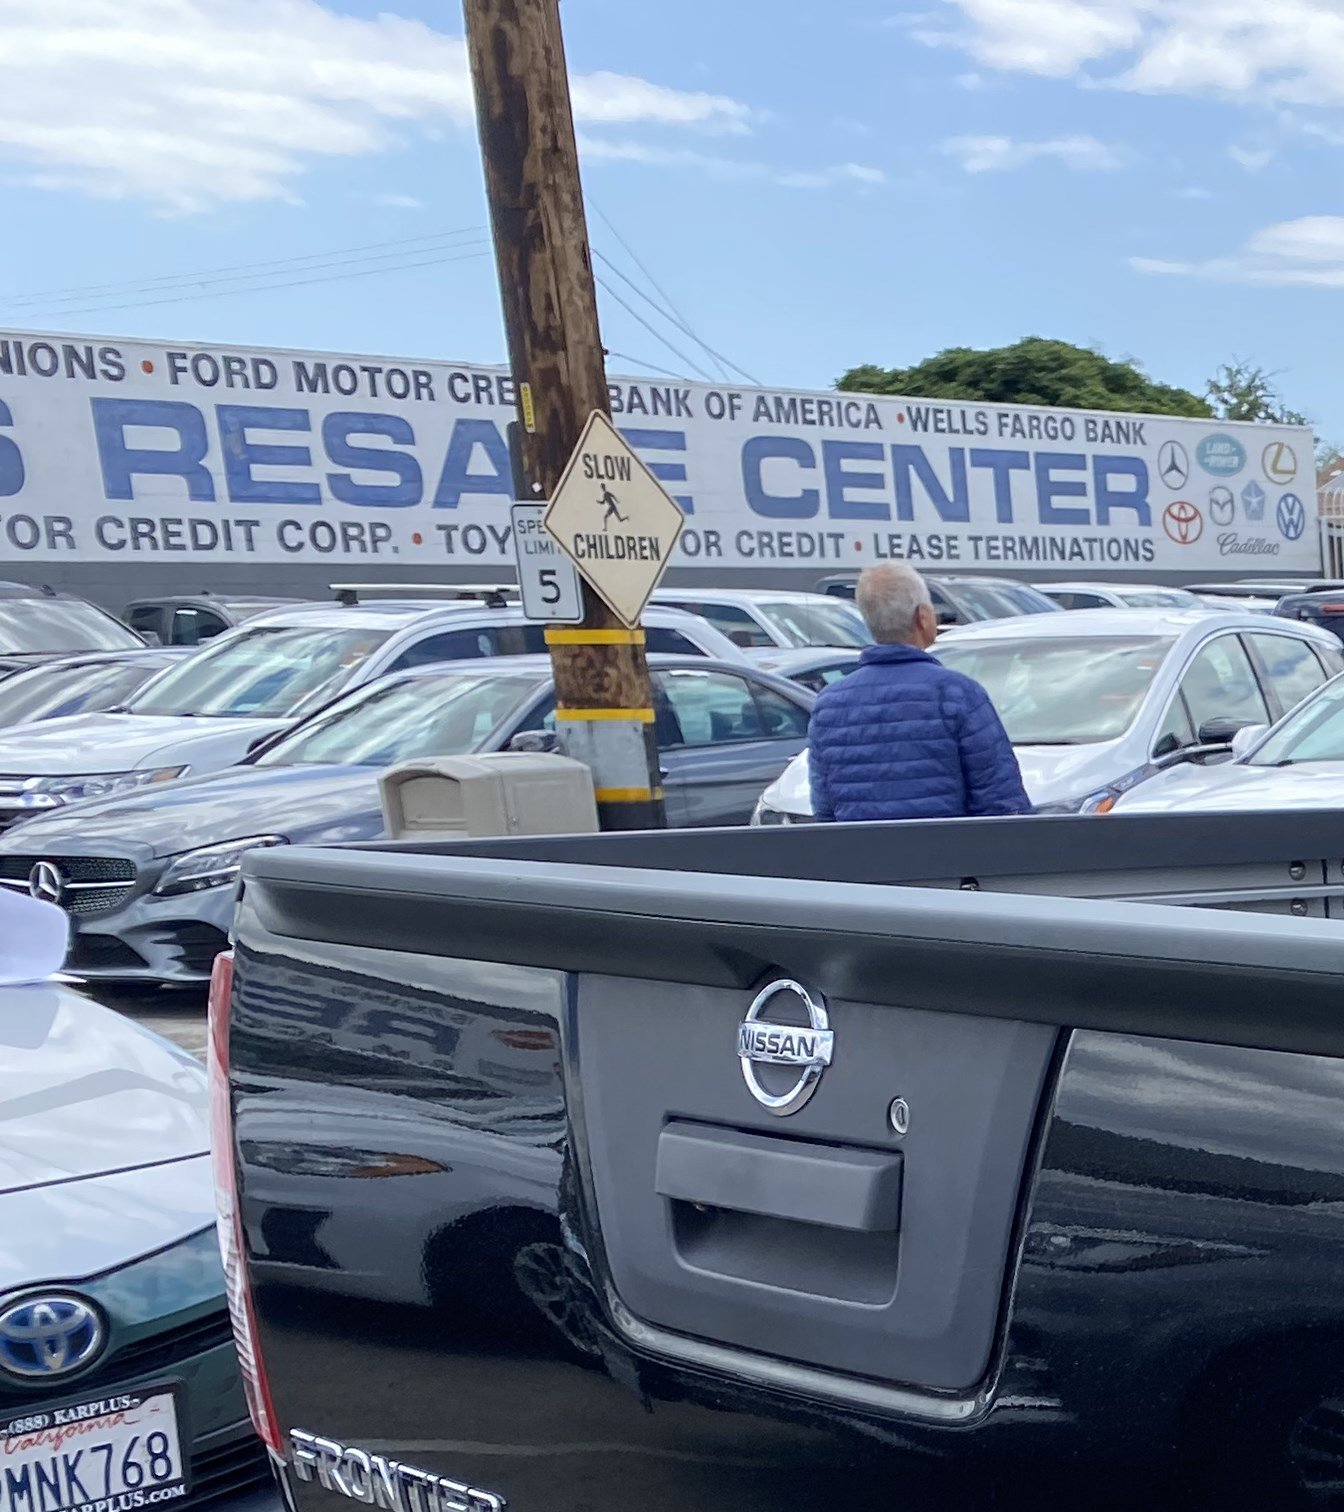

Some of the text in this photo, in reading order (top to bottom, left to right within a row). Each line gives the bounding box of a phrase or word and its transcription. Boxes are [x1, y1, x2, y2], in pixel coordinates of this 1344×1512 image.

[166, 351, 279, 390] FORD
[292, 360, 436, 401] MOTOR
[447, 372, 519, 406] CRE
[607, 384, 694, 418] BANK
[704, 391, 743, 421] OF
[752, 395, 883, 430] AMERICA
[906, 405, 989, 436] WELLS
[997, 412, 1076, 442] FARGO
[1085, 418, 1148, 446] BANK
[89, 397, 695, 516] RESAE
[741, 435, 1153, 527] CENTER
[582, 452, 632, 482] SLOW
[0, 513, 1156, 563] OR CREDIT CORP. TOY OR CREDIT LEASE TERMINATIONS
[517, 518, 547, 535] SPE
[573, 533, 661, 562] CHILDREN
[1216, 532, 1281, 557] Cadillac
[538, 569, 561, 604] 5
[740, 1027, 817, 1058] NISSAN
[54, 1395, 131, 1425] KARPLUS
